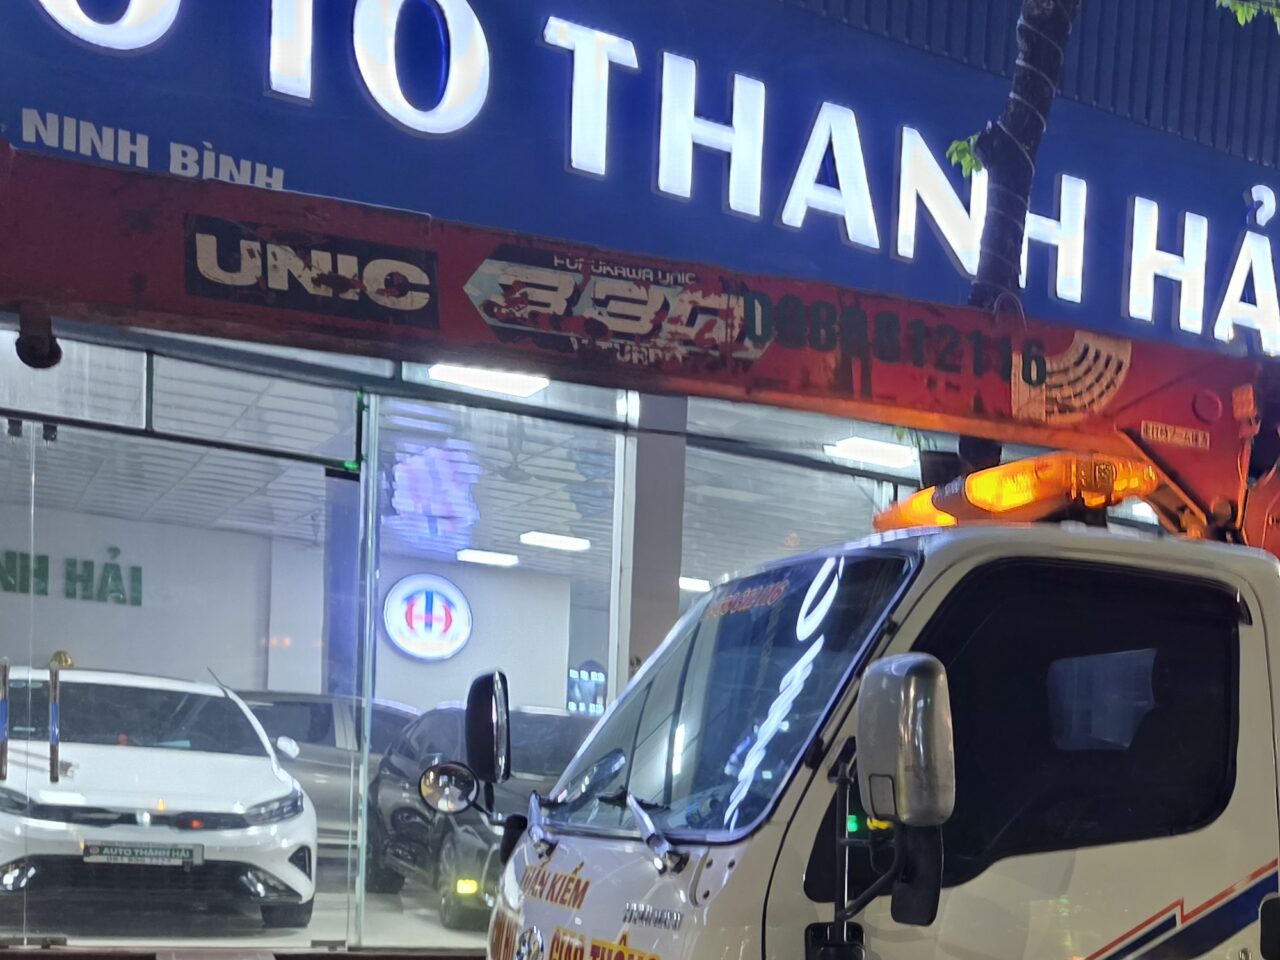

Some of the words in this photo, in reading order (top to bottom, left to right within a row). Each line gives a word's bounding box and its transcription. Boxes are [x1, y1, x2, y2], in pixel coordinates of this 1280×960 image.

[21, 107, 149, 169] NINH
[168, 140, 285, 191] BÌNH
[543, 16, 1087, 303] THANH
[196, 233, 430, 310] UNIC
[65, 546, 143, 607] HẢI
[102, 847, 132, 856] AUTO
